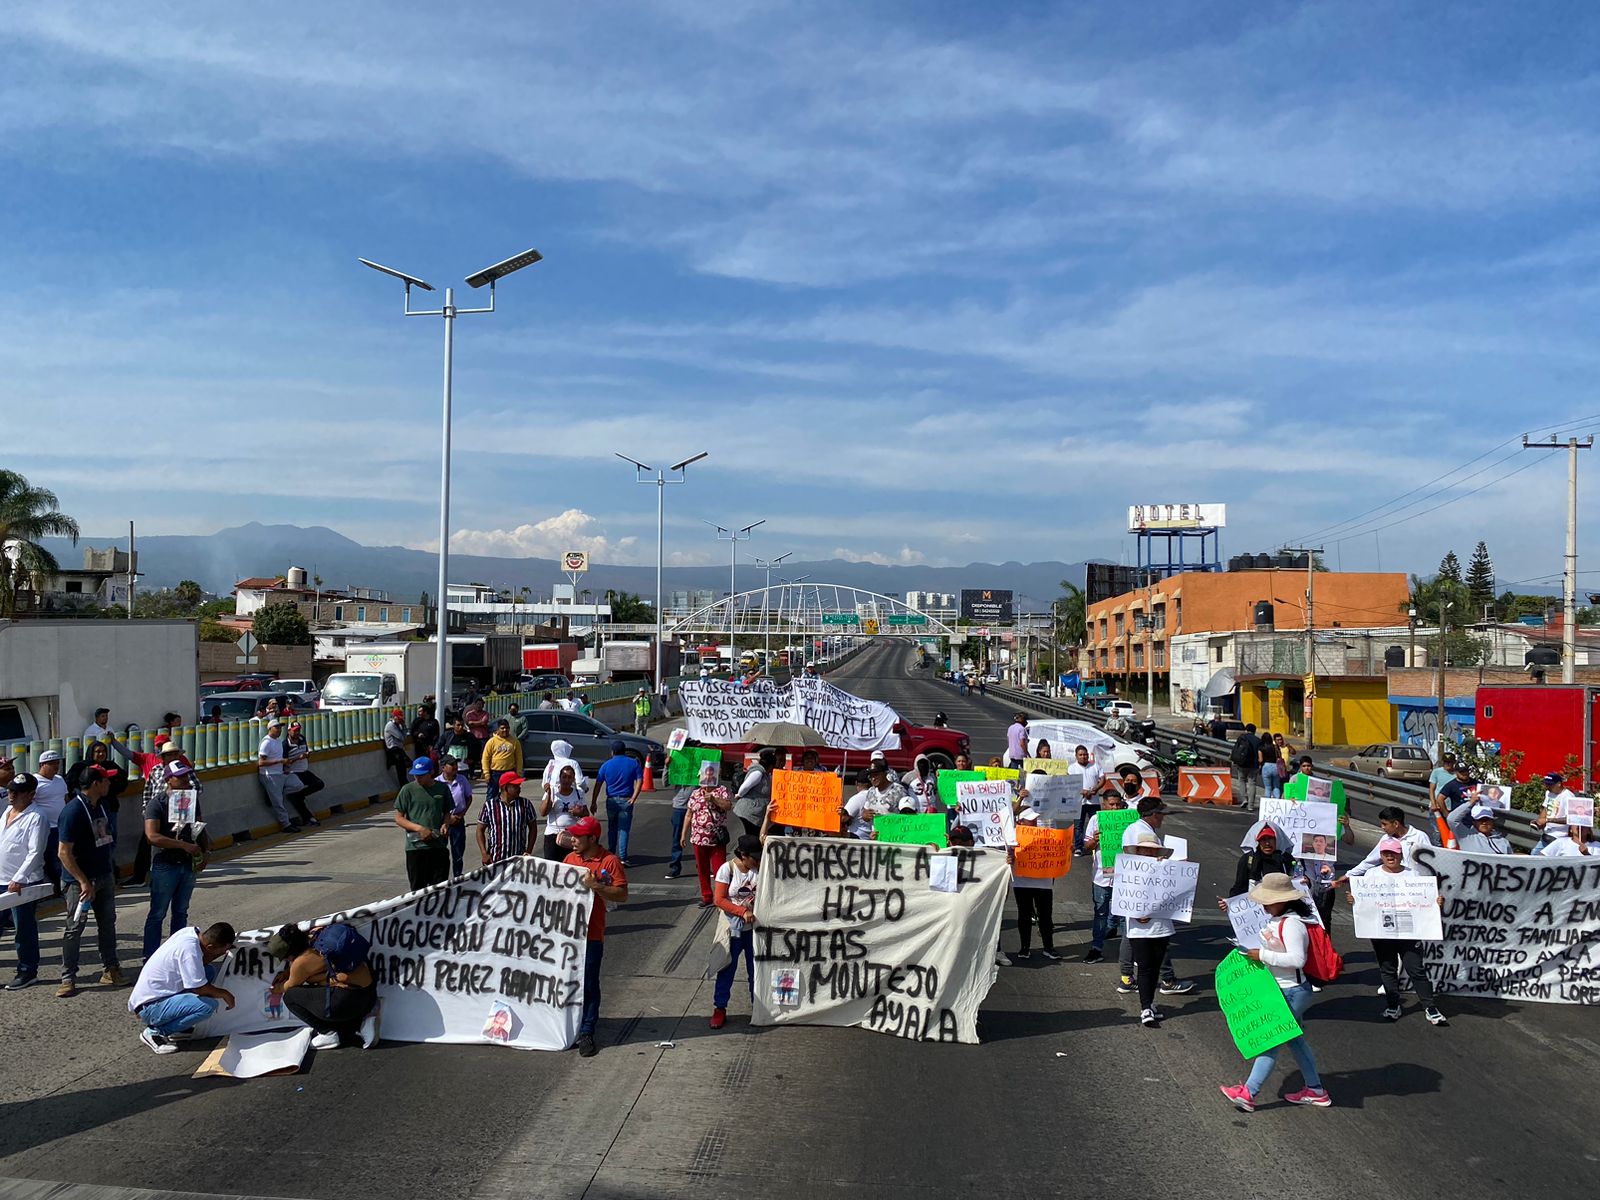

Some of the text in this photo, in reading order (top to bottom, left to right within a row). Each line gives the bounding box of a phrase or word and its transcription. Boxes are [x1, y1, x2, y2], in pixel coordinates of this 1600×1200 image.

[1135, 504, 1205, 521] HOTEL
[776, 709, 791, 719] NO
[701, 721, 760, 739] PROME
[977, 781, 1006, 795] BASTA
[961, 797, 1007, 815] NO MAS
[1263, 800, 1308, 818] ISAIAS
[1121, 860, 1199, 880] VIVOS SE LOS
[1121, 875, 1176, 889] LLEVARON
[822, 885, 906, 923] HIJO
[1118, 887, 1176, 901] VIVOS LOS
[529, 895, 588, 940] AYALA
[1534, 902, 1553, 925] A
[491, 926, 556, 965] LOPEZ
[755, 926, 868, 963] ISAIAS
[1453, 945, 1528, 966] MONTEJO
[433, 958, 496, 996] PEREZ
[808, 960, 939, 1004] MONTEJO
[869, 994, 960, 1043] AYALA
